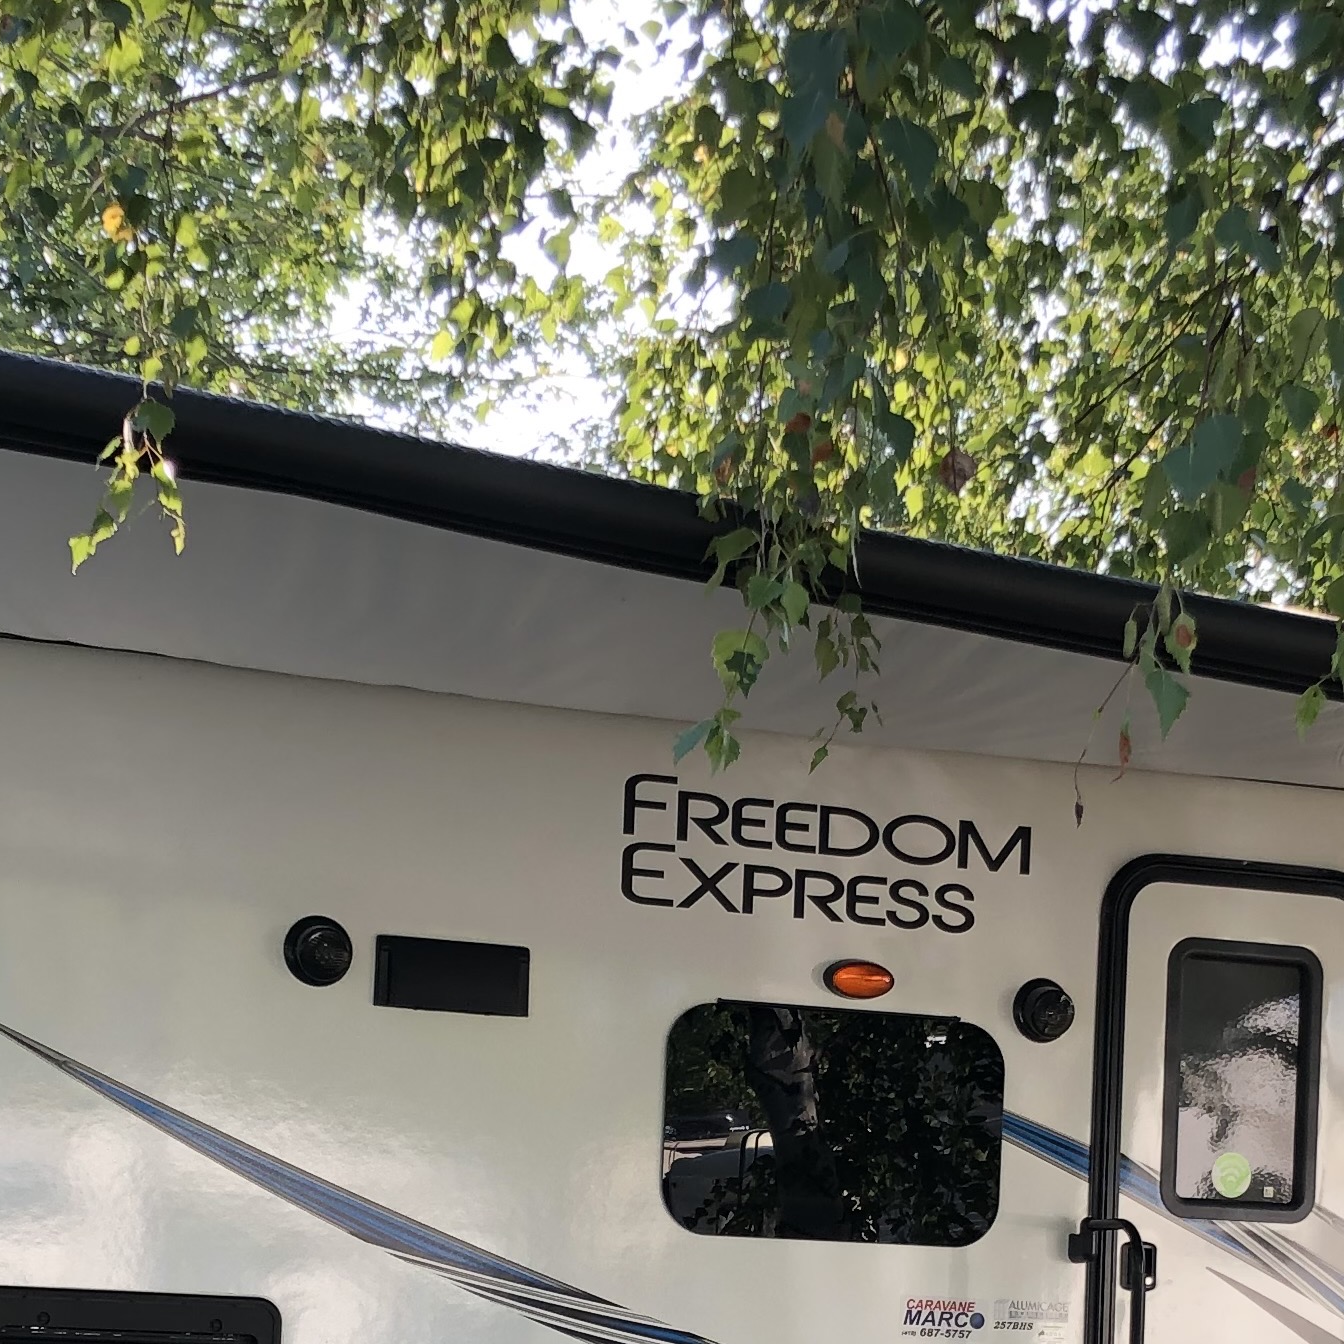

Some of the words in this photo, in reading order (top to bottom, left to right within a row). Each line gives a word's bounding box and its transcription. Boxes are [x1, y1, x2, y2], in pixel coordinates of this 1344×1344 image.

[622, 773, 1032, 875] FREEDOM
[621, 842, 975, 934] EXPRESS
[906, 1298, 976, 1313] CARAVANE
[903, 1309, 985, 1330] MARCO
[993, 1321, 1034, 1331] 257BHS
[919, 1327, 972, 1339] 687-5757
